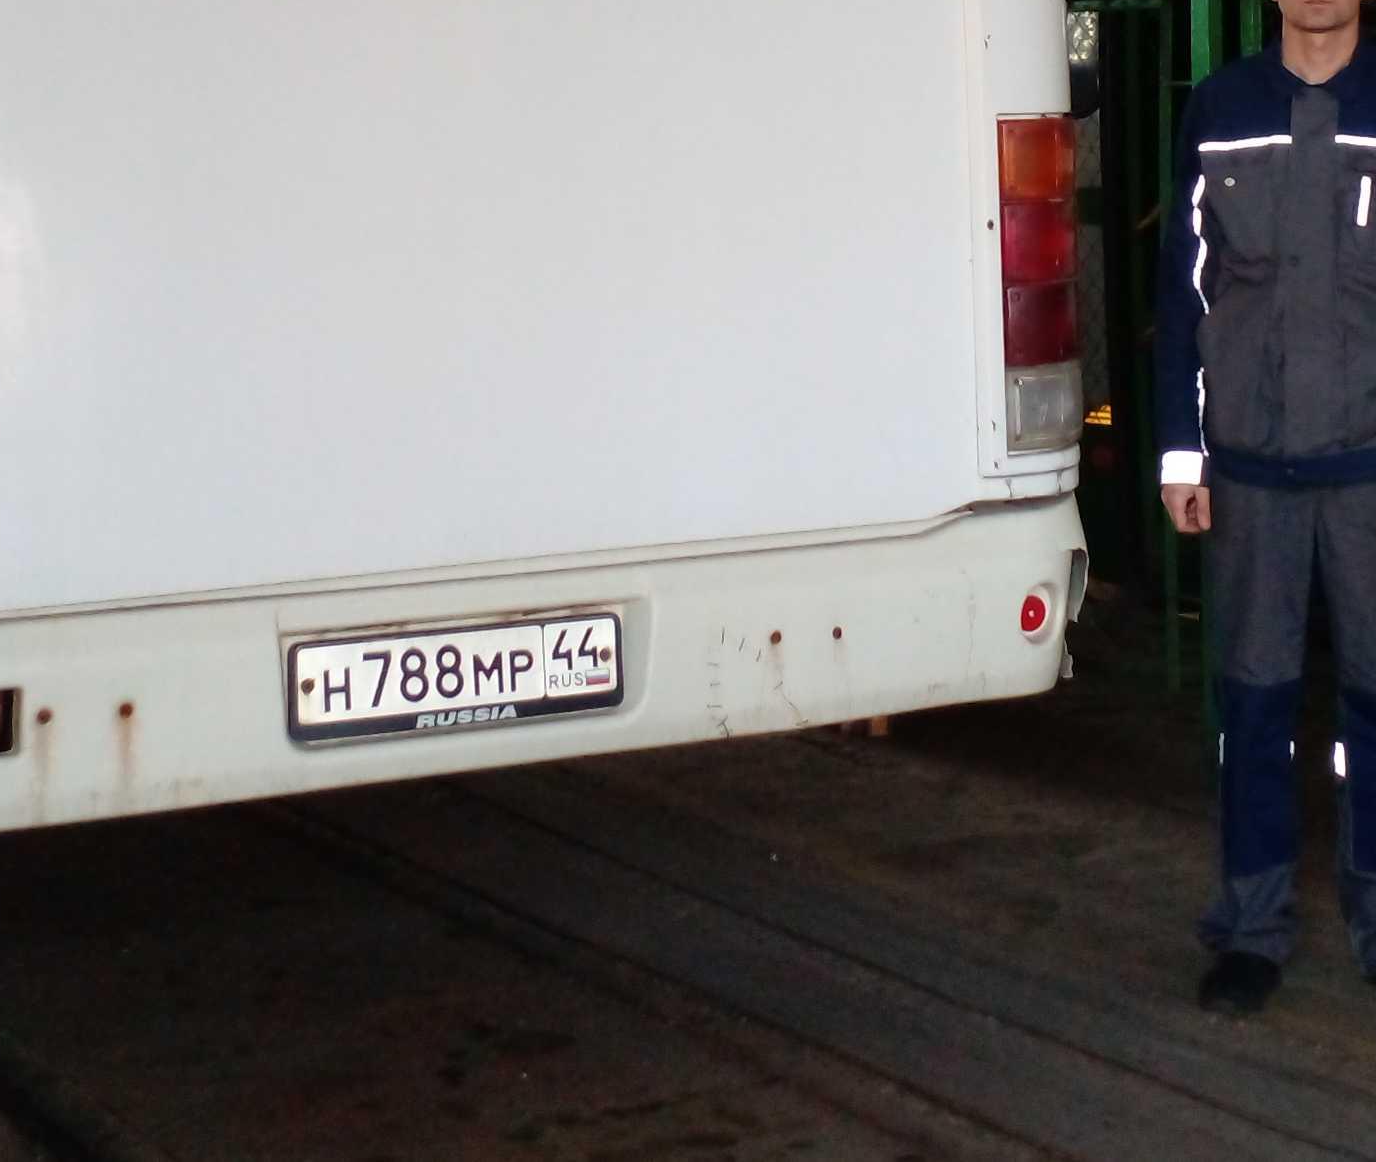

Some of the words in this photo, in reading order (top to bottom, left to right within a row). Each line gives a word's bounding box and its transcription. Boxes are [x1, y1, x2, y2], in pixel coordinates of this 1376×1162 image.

[552, 626, 598, 670] 44
[548, 670, 584, 689] RUS
[415, 703, 518, 729] RUSSIA
